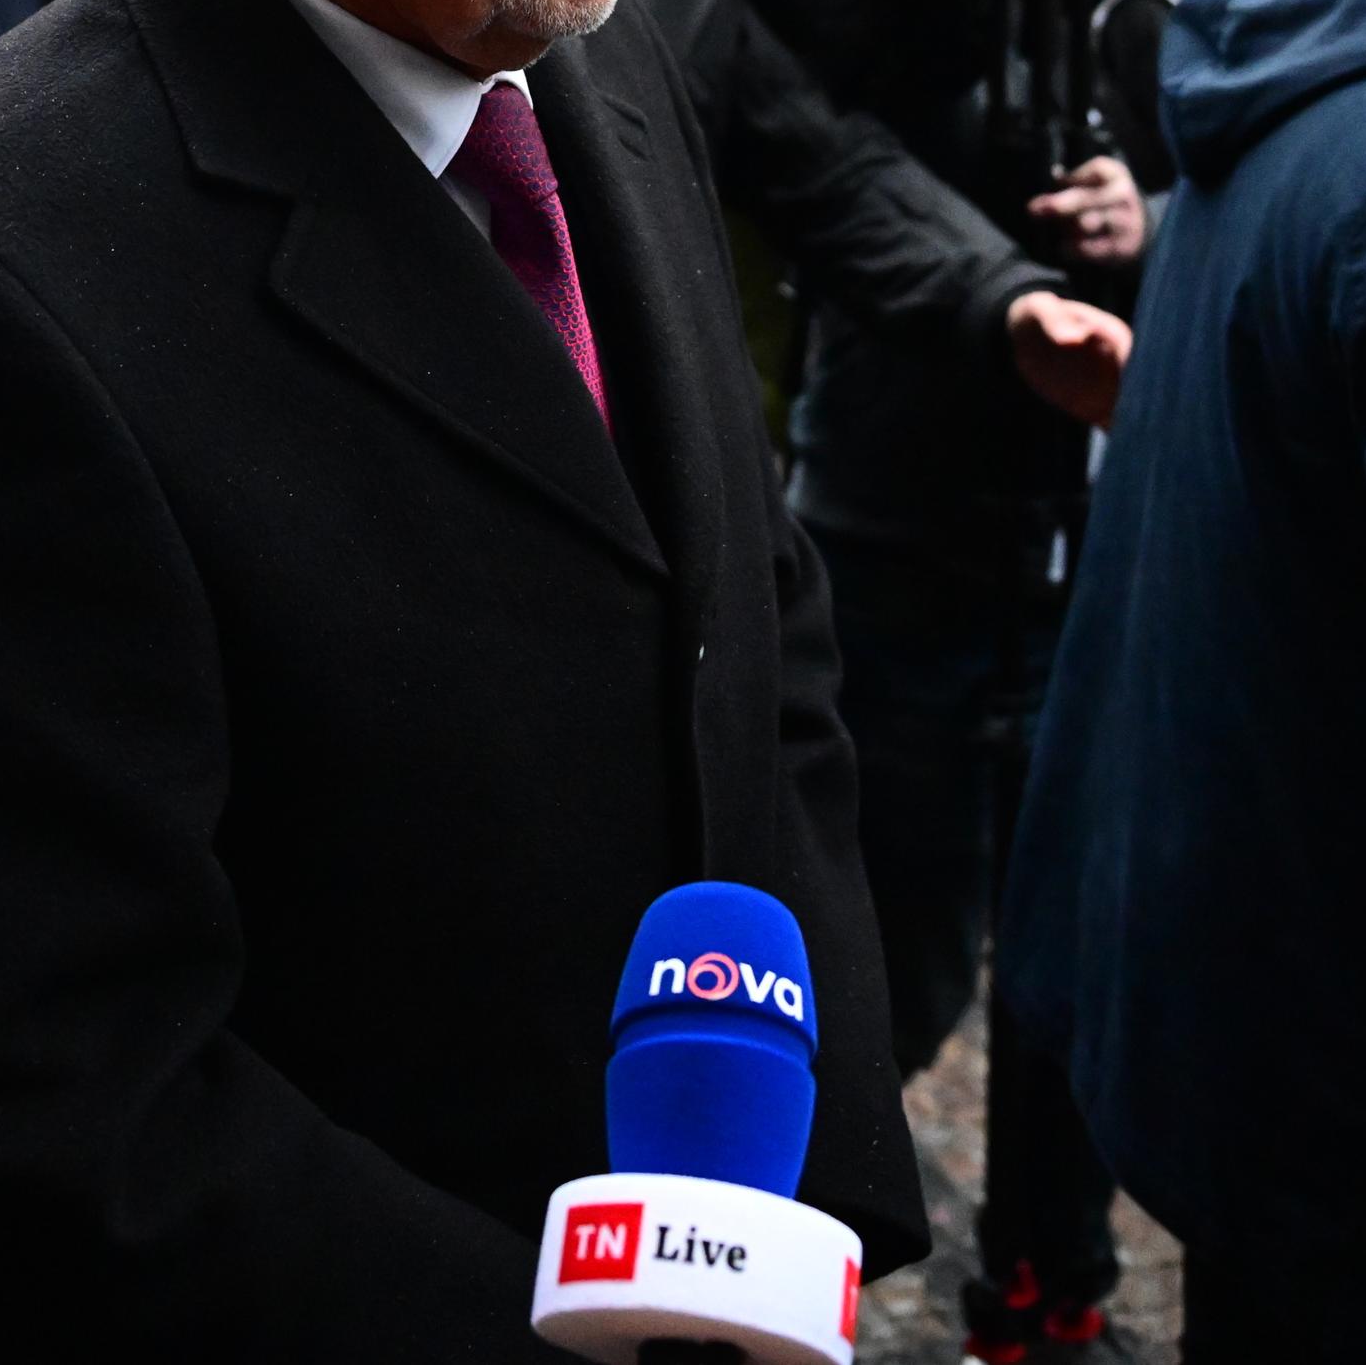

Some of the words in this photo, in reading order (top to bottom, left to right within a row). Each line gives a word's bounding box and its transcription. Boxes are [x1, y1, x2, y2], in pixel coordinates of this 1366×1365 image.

[649, 952, 803, 1021] nova
[576, 1224, 627, 1260] TN
[653, 1225, 748, 1272] Live
